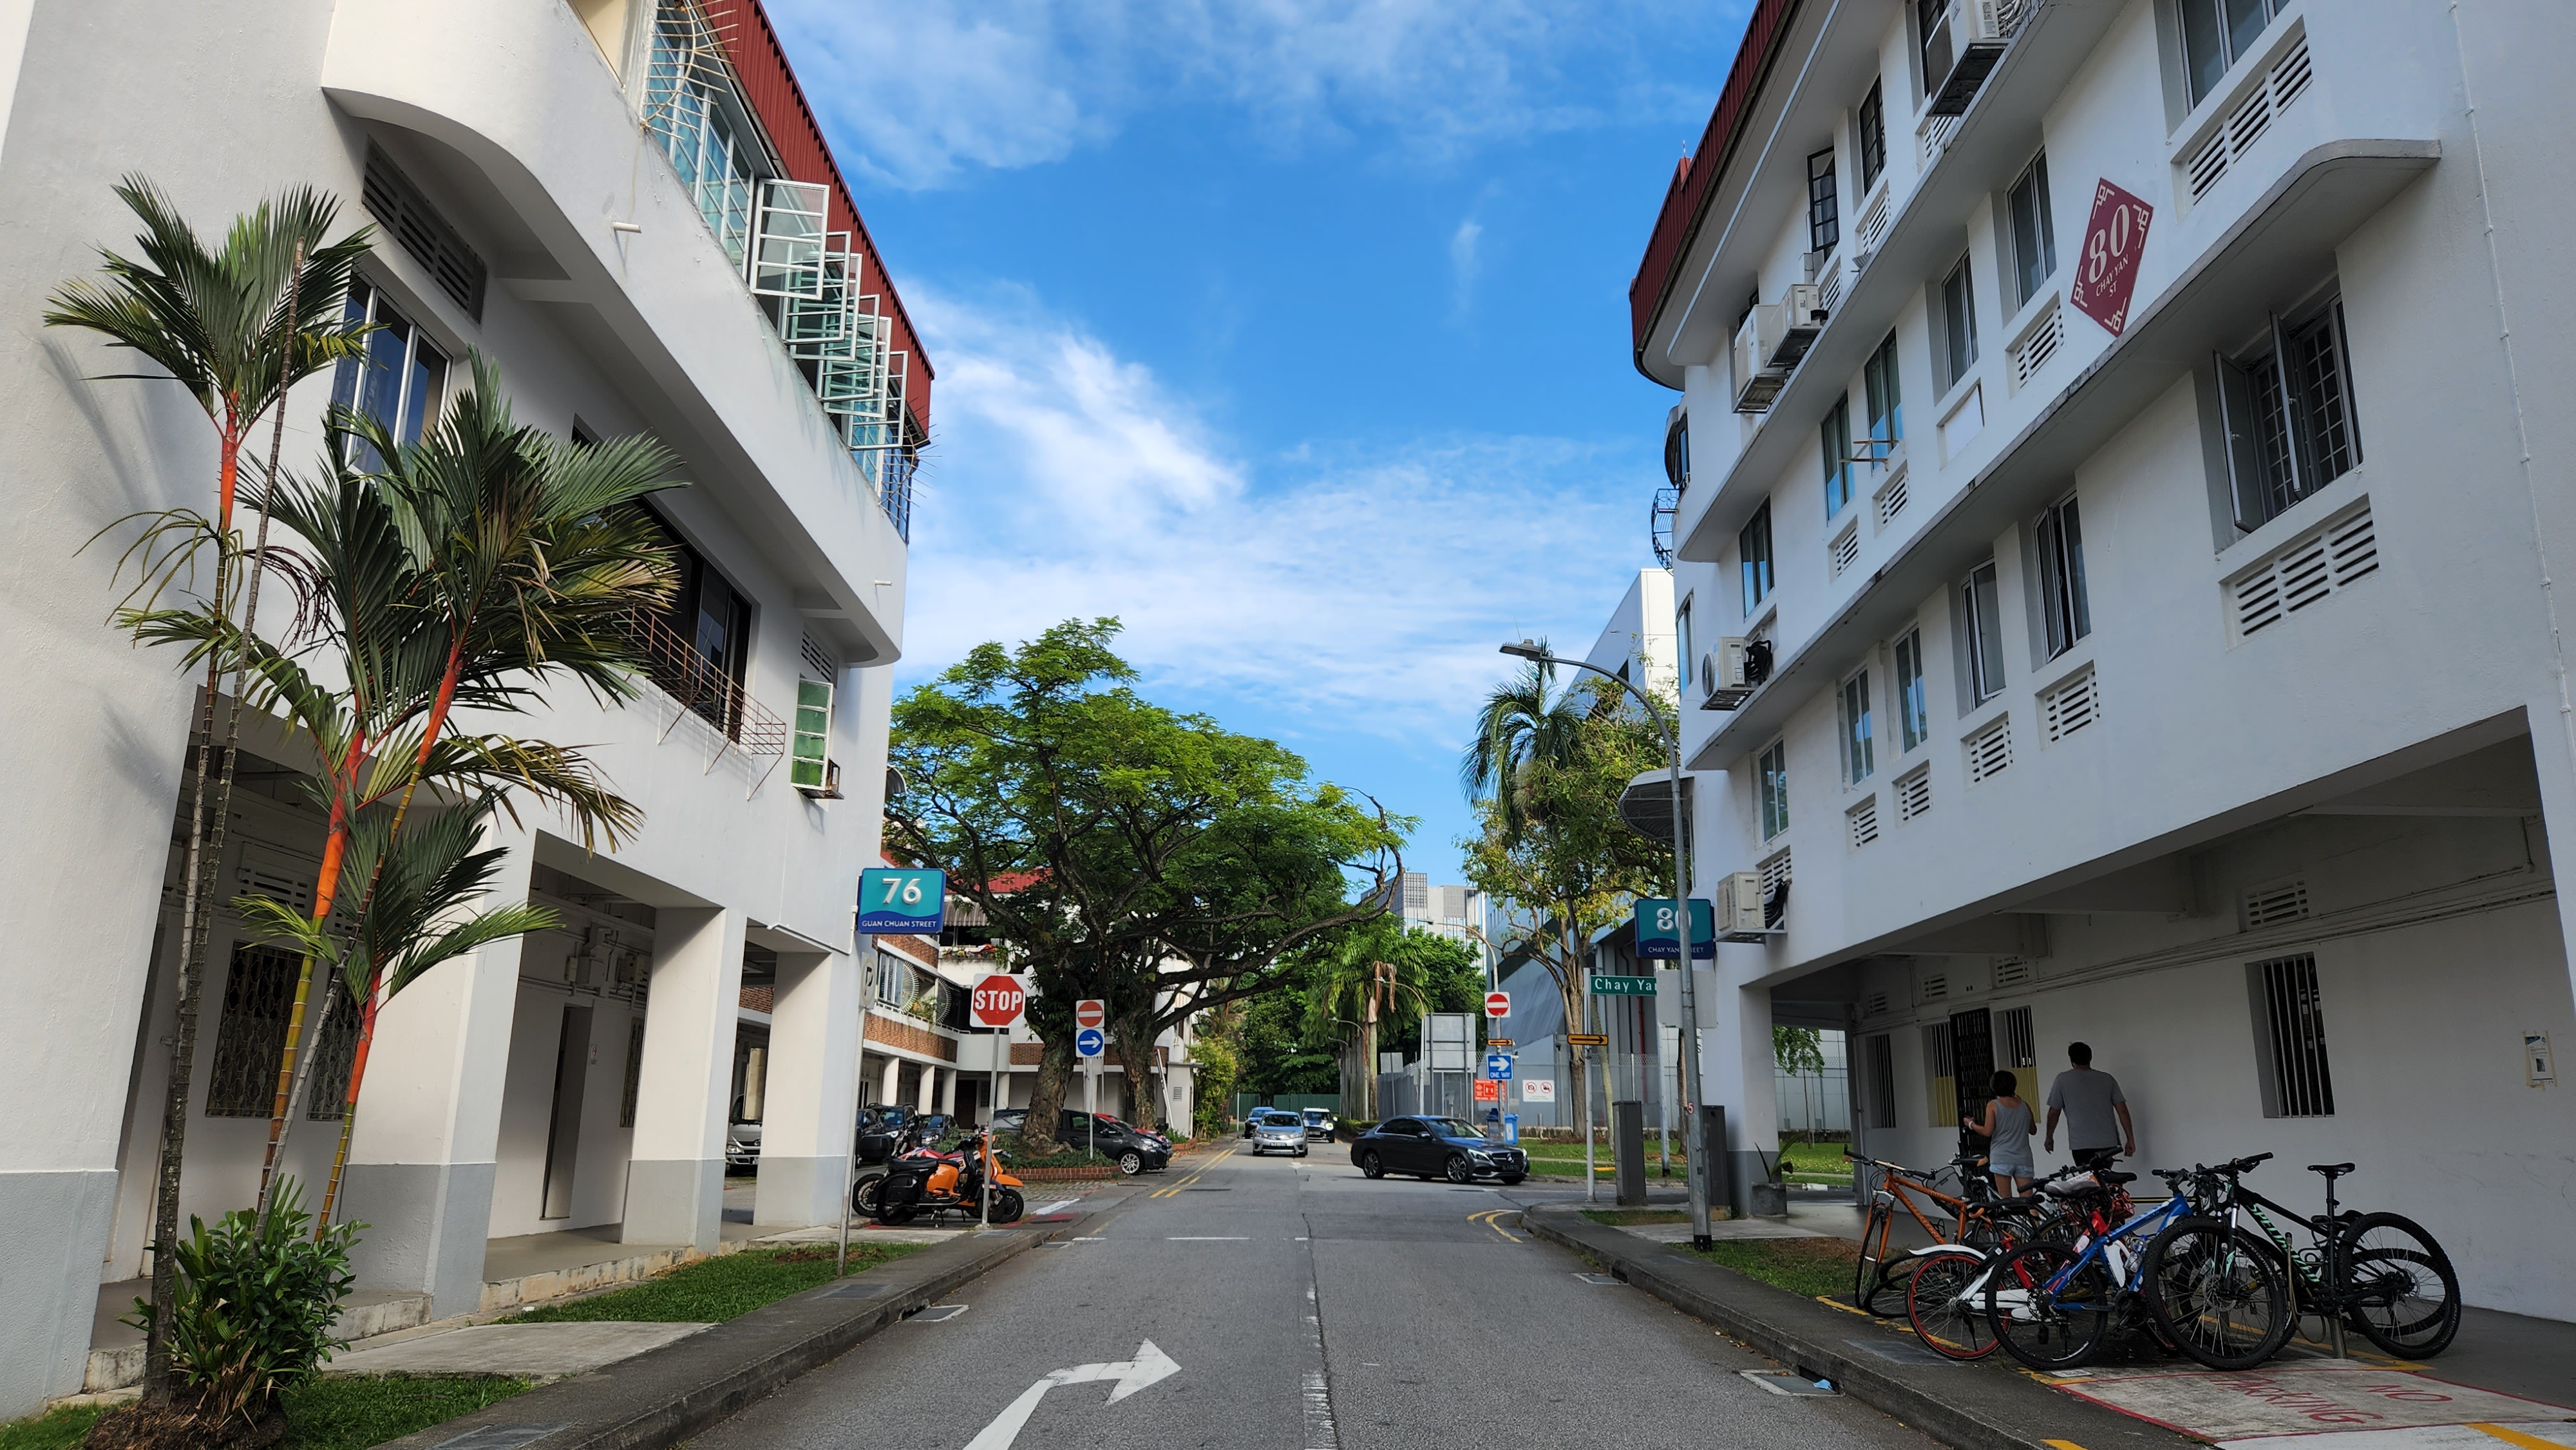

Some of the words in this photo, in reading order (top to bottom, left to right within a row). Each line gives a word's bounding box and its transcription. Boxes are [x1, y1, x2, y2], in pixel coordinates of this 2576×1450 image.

[2088, 204, 2130, 284] 80
[2096, 269, 2114, 297] CHAY
[2114, 254, 2129, 276] YAN
[2109, 280, 2117, 297] ST
[882, 878, 922, 905] 76
[1595, 978, 1629, 993] Chay
[974, 990, 1023, 1012] STOP
[2210, 1377, 2384, 1424] PARKING
[2347, 1384, 2454, 1402] NO
